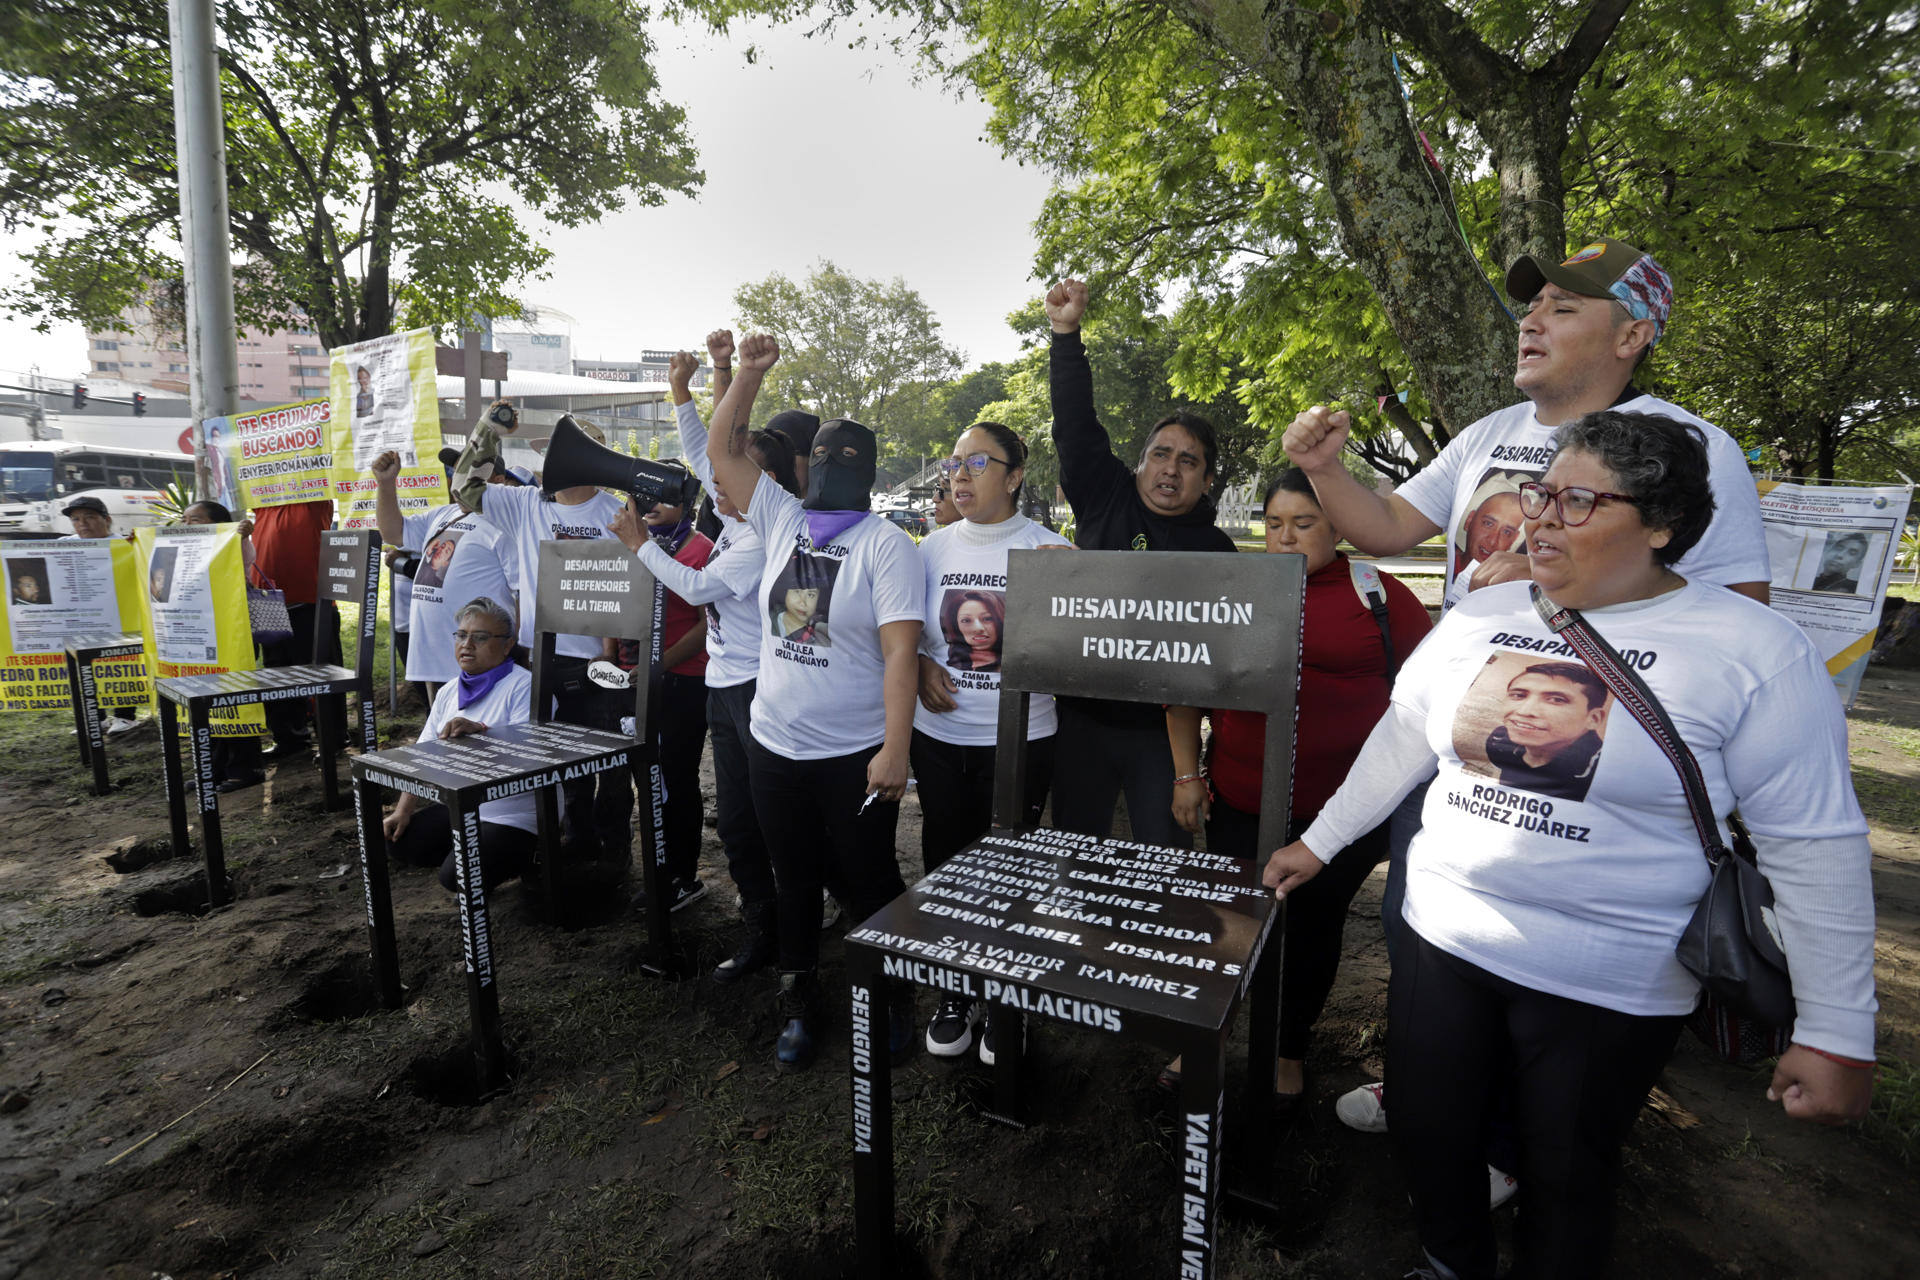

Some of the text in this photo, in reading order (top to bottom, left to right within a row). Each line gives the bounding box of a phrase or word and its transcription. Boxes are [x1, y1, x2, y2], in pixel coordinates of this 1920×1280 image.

[587, 371, 629, 380] ABOGADOS
[260, 402, 330, 432] SEGUIMOS
[242, 426, 322, 458] BUSCANDO!
[240, 463, 274, 479] JENYFER
[275, 456, 310, 473] ROMÁN
[407, 498, 429, 508] MOYA
[1789, 503, 1799, 511] DE
[552, 524, 602, 537] DESAPARECIDA
[339, 552, 348, 561] POR
[564, 556, 629, 573] DESAPARICIÓN
[365, 546, 379, 637] ARIANA CORONA
[560, 579, 631, 593] DE DEFENSORES
[940, 573, 1007, 587] DESAPAREC
[563, 599, 621, 613] DE LA TIERRA
[1051, 595, 1253, 625] DESAPARICIÓN
[6, 656, 19, 666] ¡TE
[794, 654, 829, 668] AGUAYO
[1082, 636, 1212, 665] FORZADA
[0, 668, 35, 682] EDRO
[951, 678, 974, 689] CHOA
[962, 672, 990, 681] EMMA
[81, 665, 101, 739] MARIO ALBERTO
[102, 697, 115, 706] DE
[212, 684, 331, 707] JAVIER RODRÍGUEZ
[363, 701, 375, 744] RAFAEL
[197, 728, 216, 811] OSVALDO BÁEZ
[365, 768, 441, 802] CARINA RODRÍGUEZ
[486, 752, 628, 801] RUBICELA ALVILLAR
[650, 764, 666, 866] OSVALDO BÁEZ
[1447, 791, 1591, 843] SÁNCHEZ JUÁREZ
[1472, 784, 1553, 818] RODRIGO
[354, 789, 367, 863] FRANCISCO
[362, 866, 375, 927] SÁNCHEZ
[452, 829, 466, 890] FANNY
[967, 849, 1058, 871] ARAMTZA
[980, 836, 1180, 875] RODRIGO SÁNCHEZ
[1020, 832, 1242, 873] MORALES ROSALES
[1034, 827, 1235, 864] NADIA GUADALUPE
[951, 854, 1060, 881] SEVERIANO
[1115, 869, 1269, 898] FERNANDA HDEZ.
[464, 811, 492, 988] MONSERRAT MURRIETA
[916, 885, 1012, 912] ANALÍ M
[927, 872, 1087, 910] OSVALDO BÁEZ
[941, 864, 1163, 913] BRANDON RAMÍREZ
[1068, 870, 1236, 903] GALILEA CRUZ
[918, 902, 1083, 947] EDWIN ARIEL
[1032, 903, 1213, 944] EMMA OCHOA
[851, 928, 1047, 982] JENYFER SOLET
[937, 935, 1200, 1000] SALVADOR RAMÍREZ
[1103, 941, 1242, 976] JOSMAR S
[883, 954, 1122, 1032] MICHEL PALACIOS
[852, 985, 872, 1153] SERGIO RUEDA
[1184, 1113, 1210, 1193] YAFET
[1183, 1192, 1210, 1249] ISAÍ
